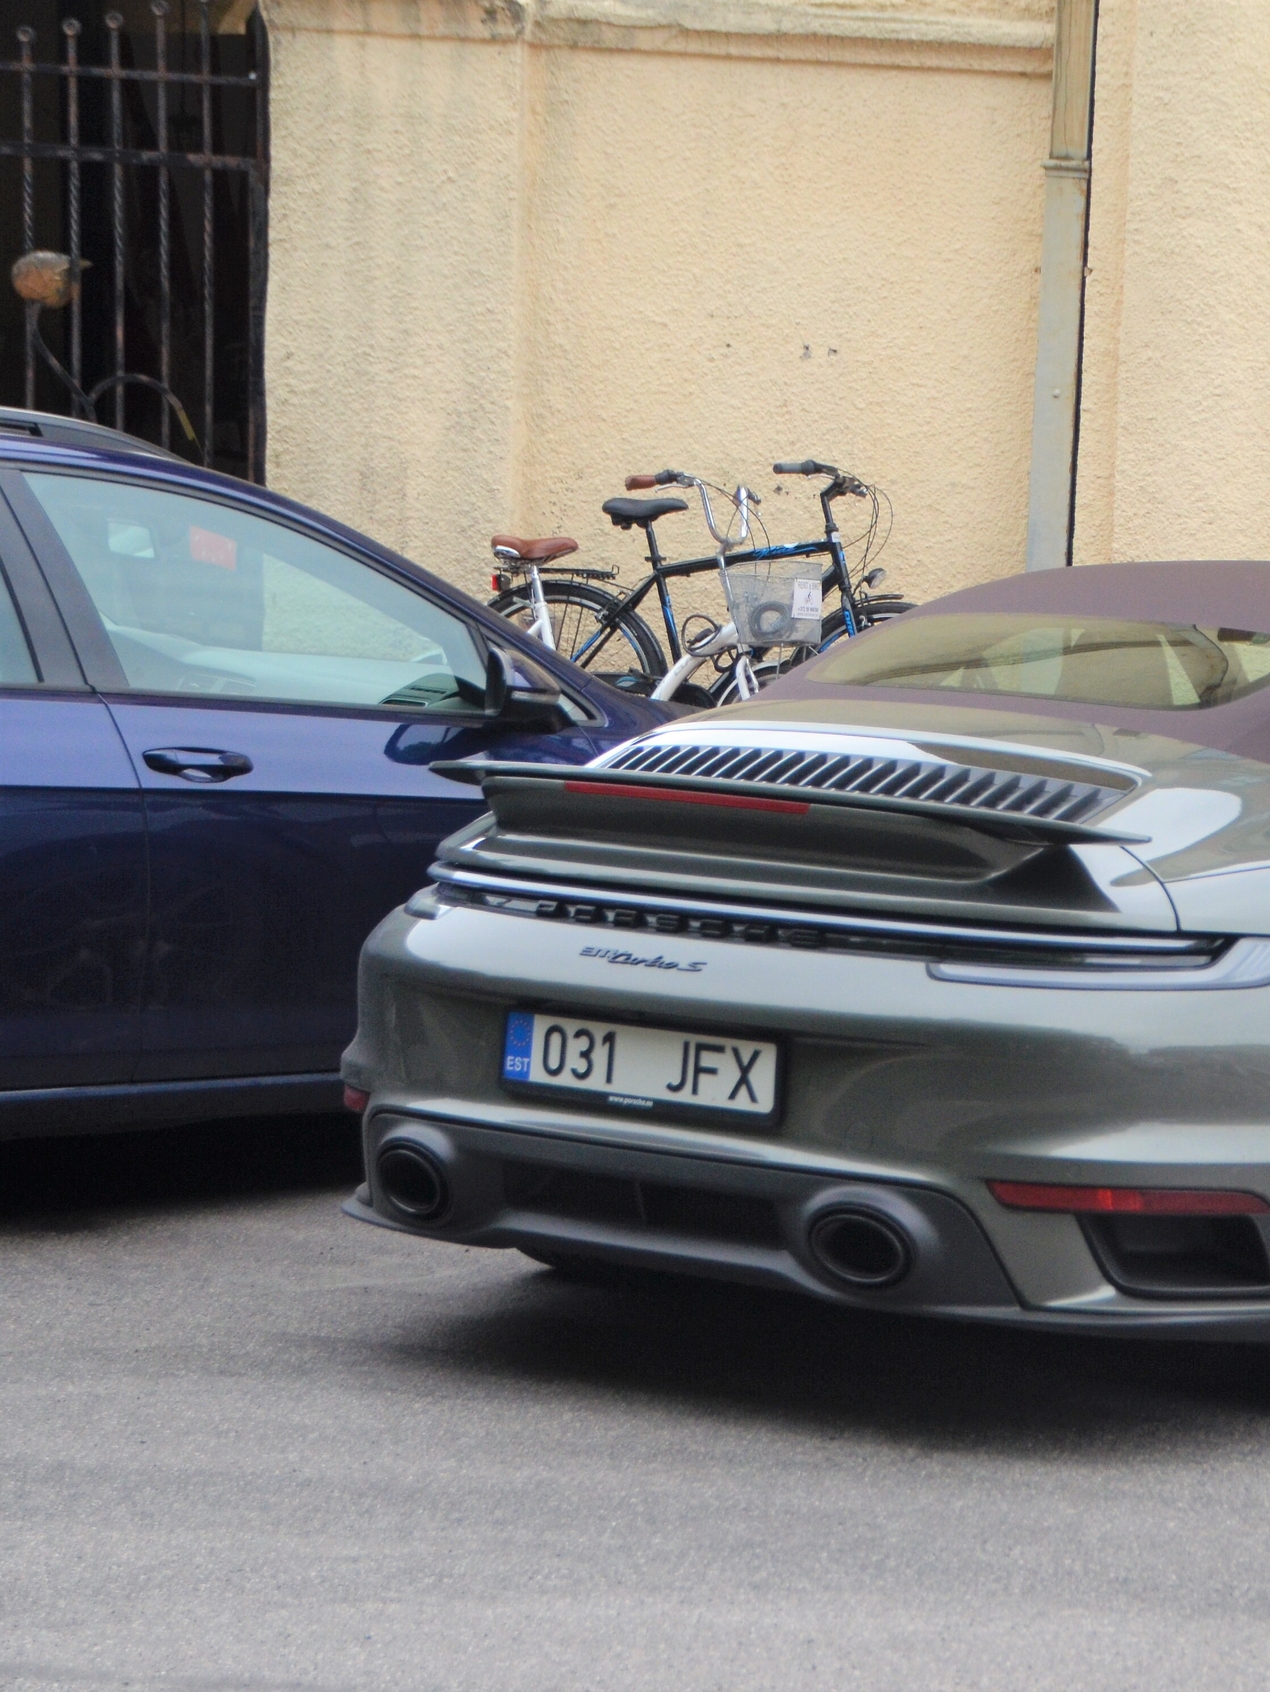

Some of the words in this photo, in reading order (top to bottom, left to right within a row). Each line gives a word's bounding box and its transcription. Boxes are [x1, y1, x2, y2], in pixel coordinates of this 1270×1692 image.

[535, 899, 824, 948] PORSCHE
[676, 961, 708, 973] S
[506, 1055, 530, 1072] EST
[542, 1024, 617, 1084] 031
[666, 1041, 762, 1104] JFX
